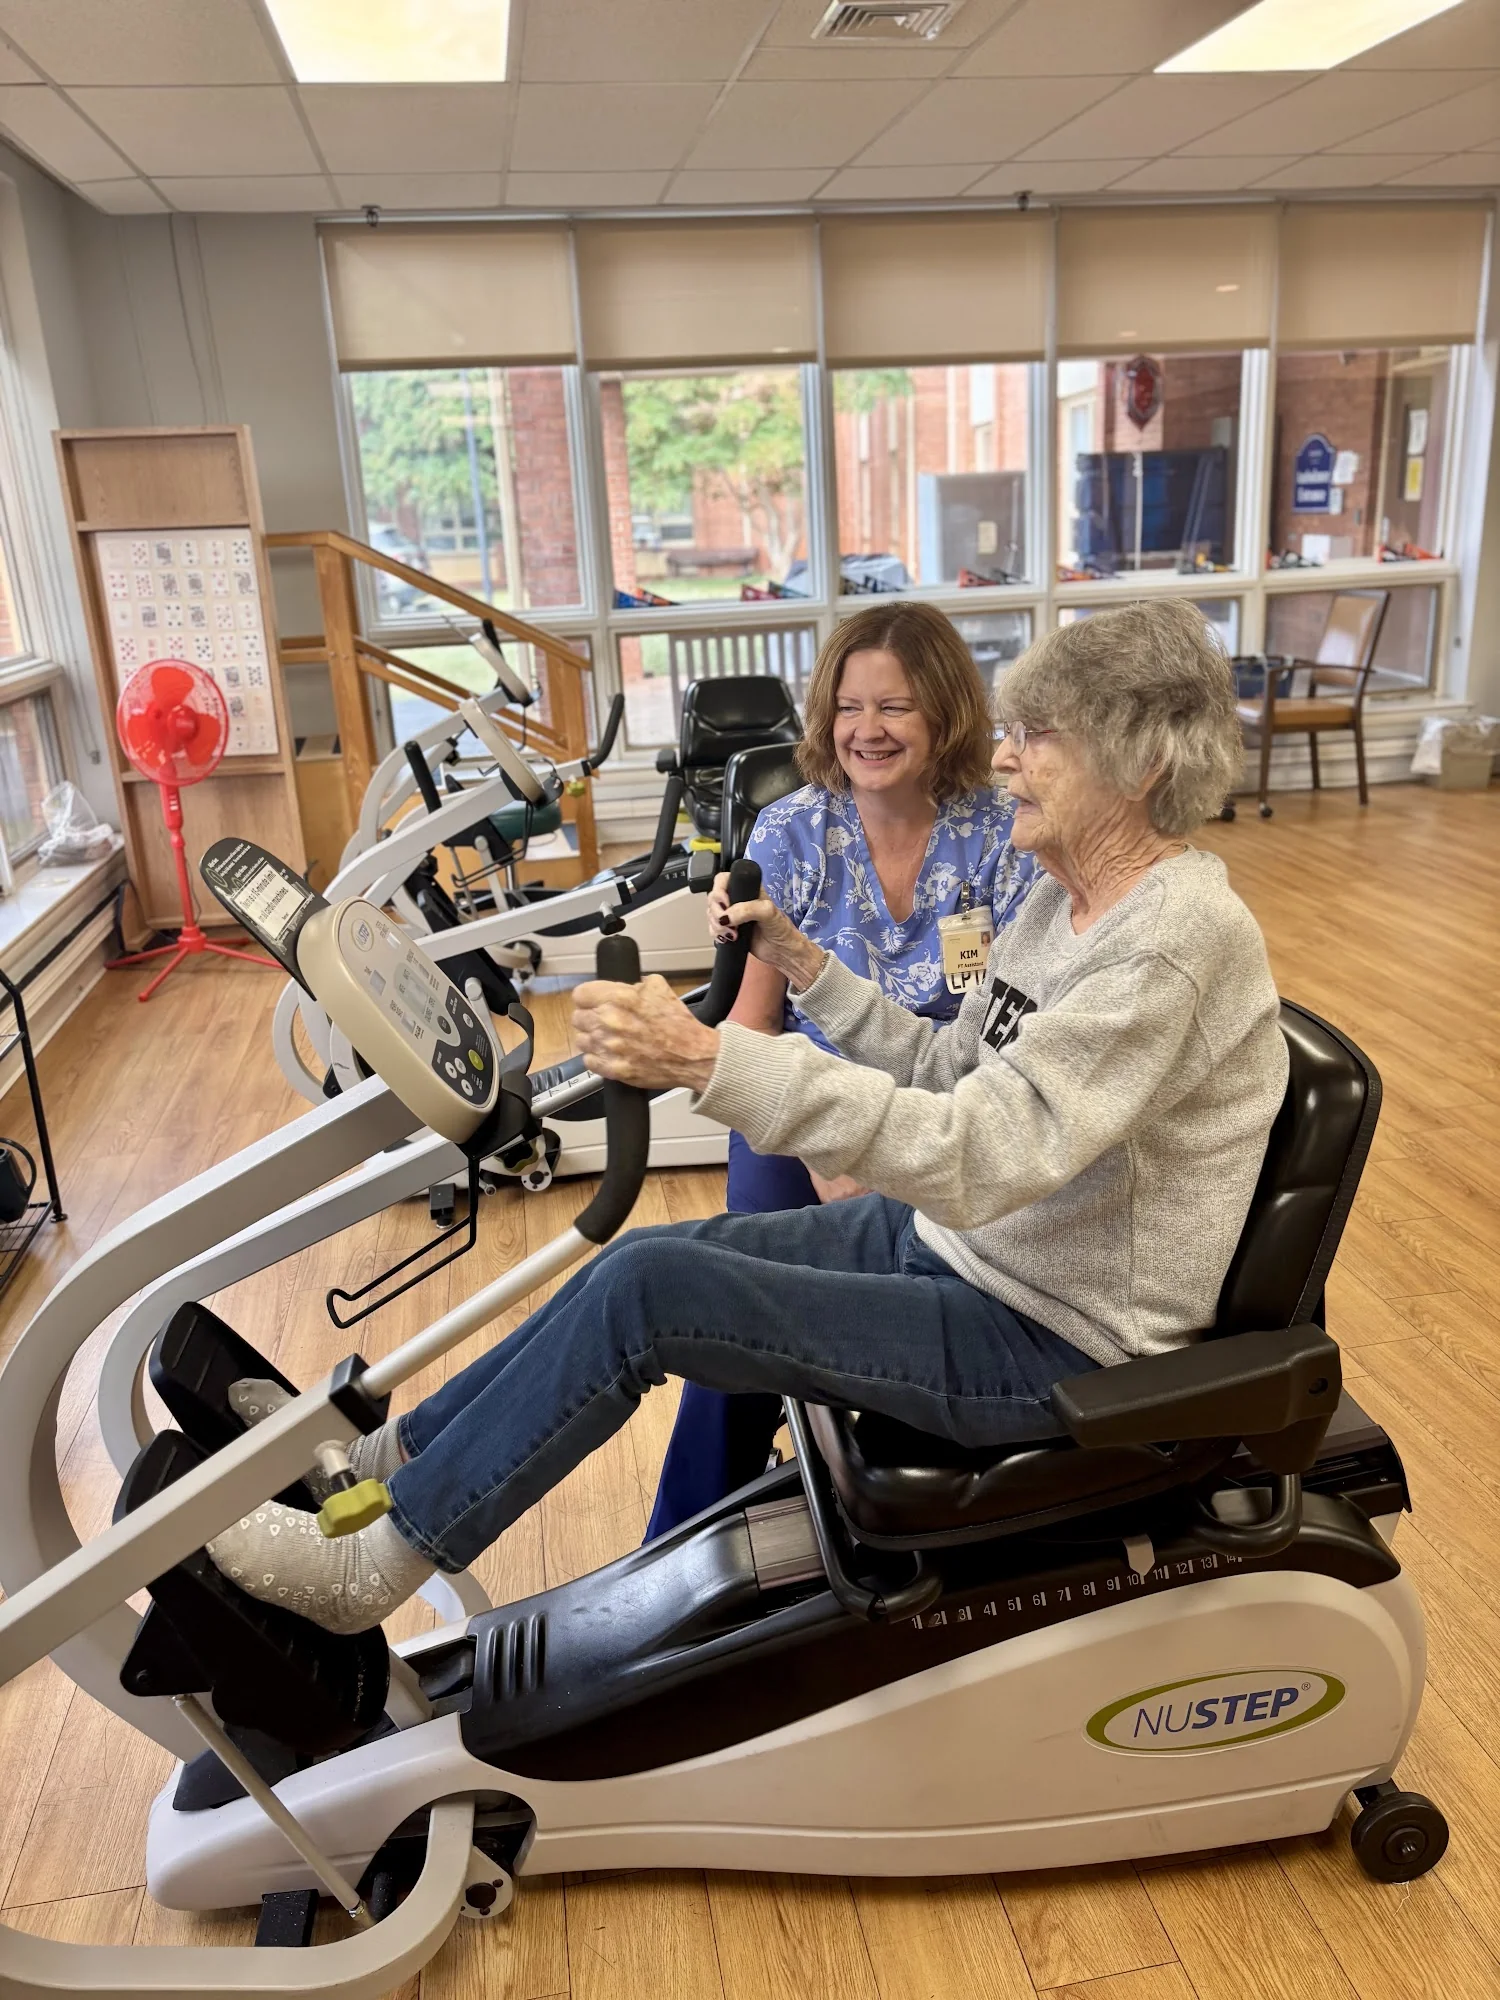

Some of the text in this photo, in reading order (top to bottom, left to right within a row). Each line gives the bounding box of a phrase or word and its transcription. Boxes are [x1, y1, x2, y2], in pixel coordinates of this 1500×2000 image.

[960, 949, 978, 960] KIM
[934, 1613, 942, 1625] 2
[958, 1609, 966, 1620] 3
[983, 1604, 991, 1615] 4
[1008, 1599, 1015, 1611] 5
[1032, 1594, 1041, 1606] 6
[1057, 1590, 1064, 1601] 7
[1082, 1584, 1091, 1596] 8
[1107, 1579, 1114, 1591] 9
[1127, 1574, 1139, 1586] 10
[1153, 1568, 1164, 1580] 11
[1176, 1562, 1188, 1575] 12
[1200, 1557, 1212, 1569] 13
